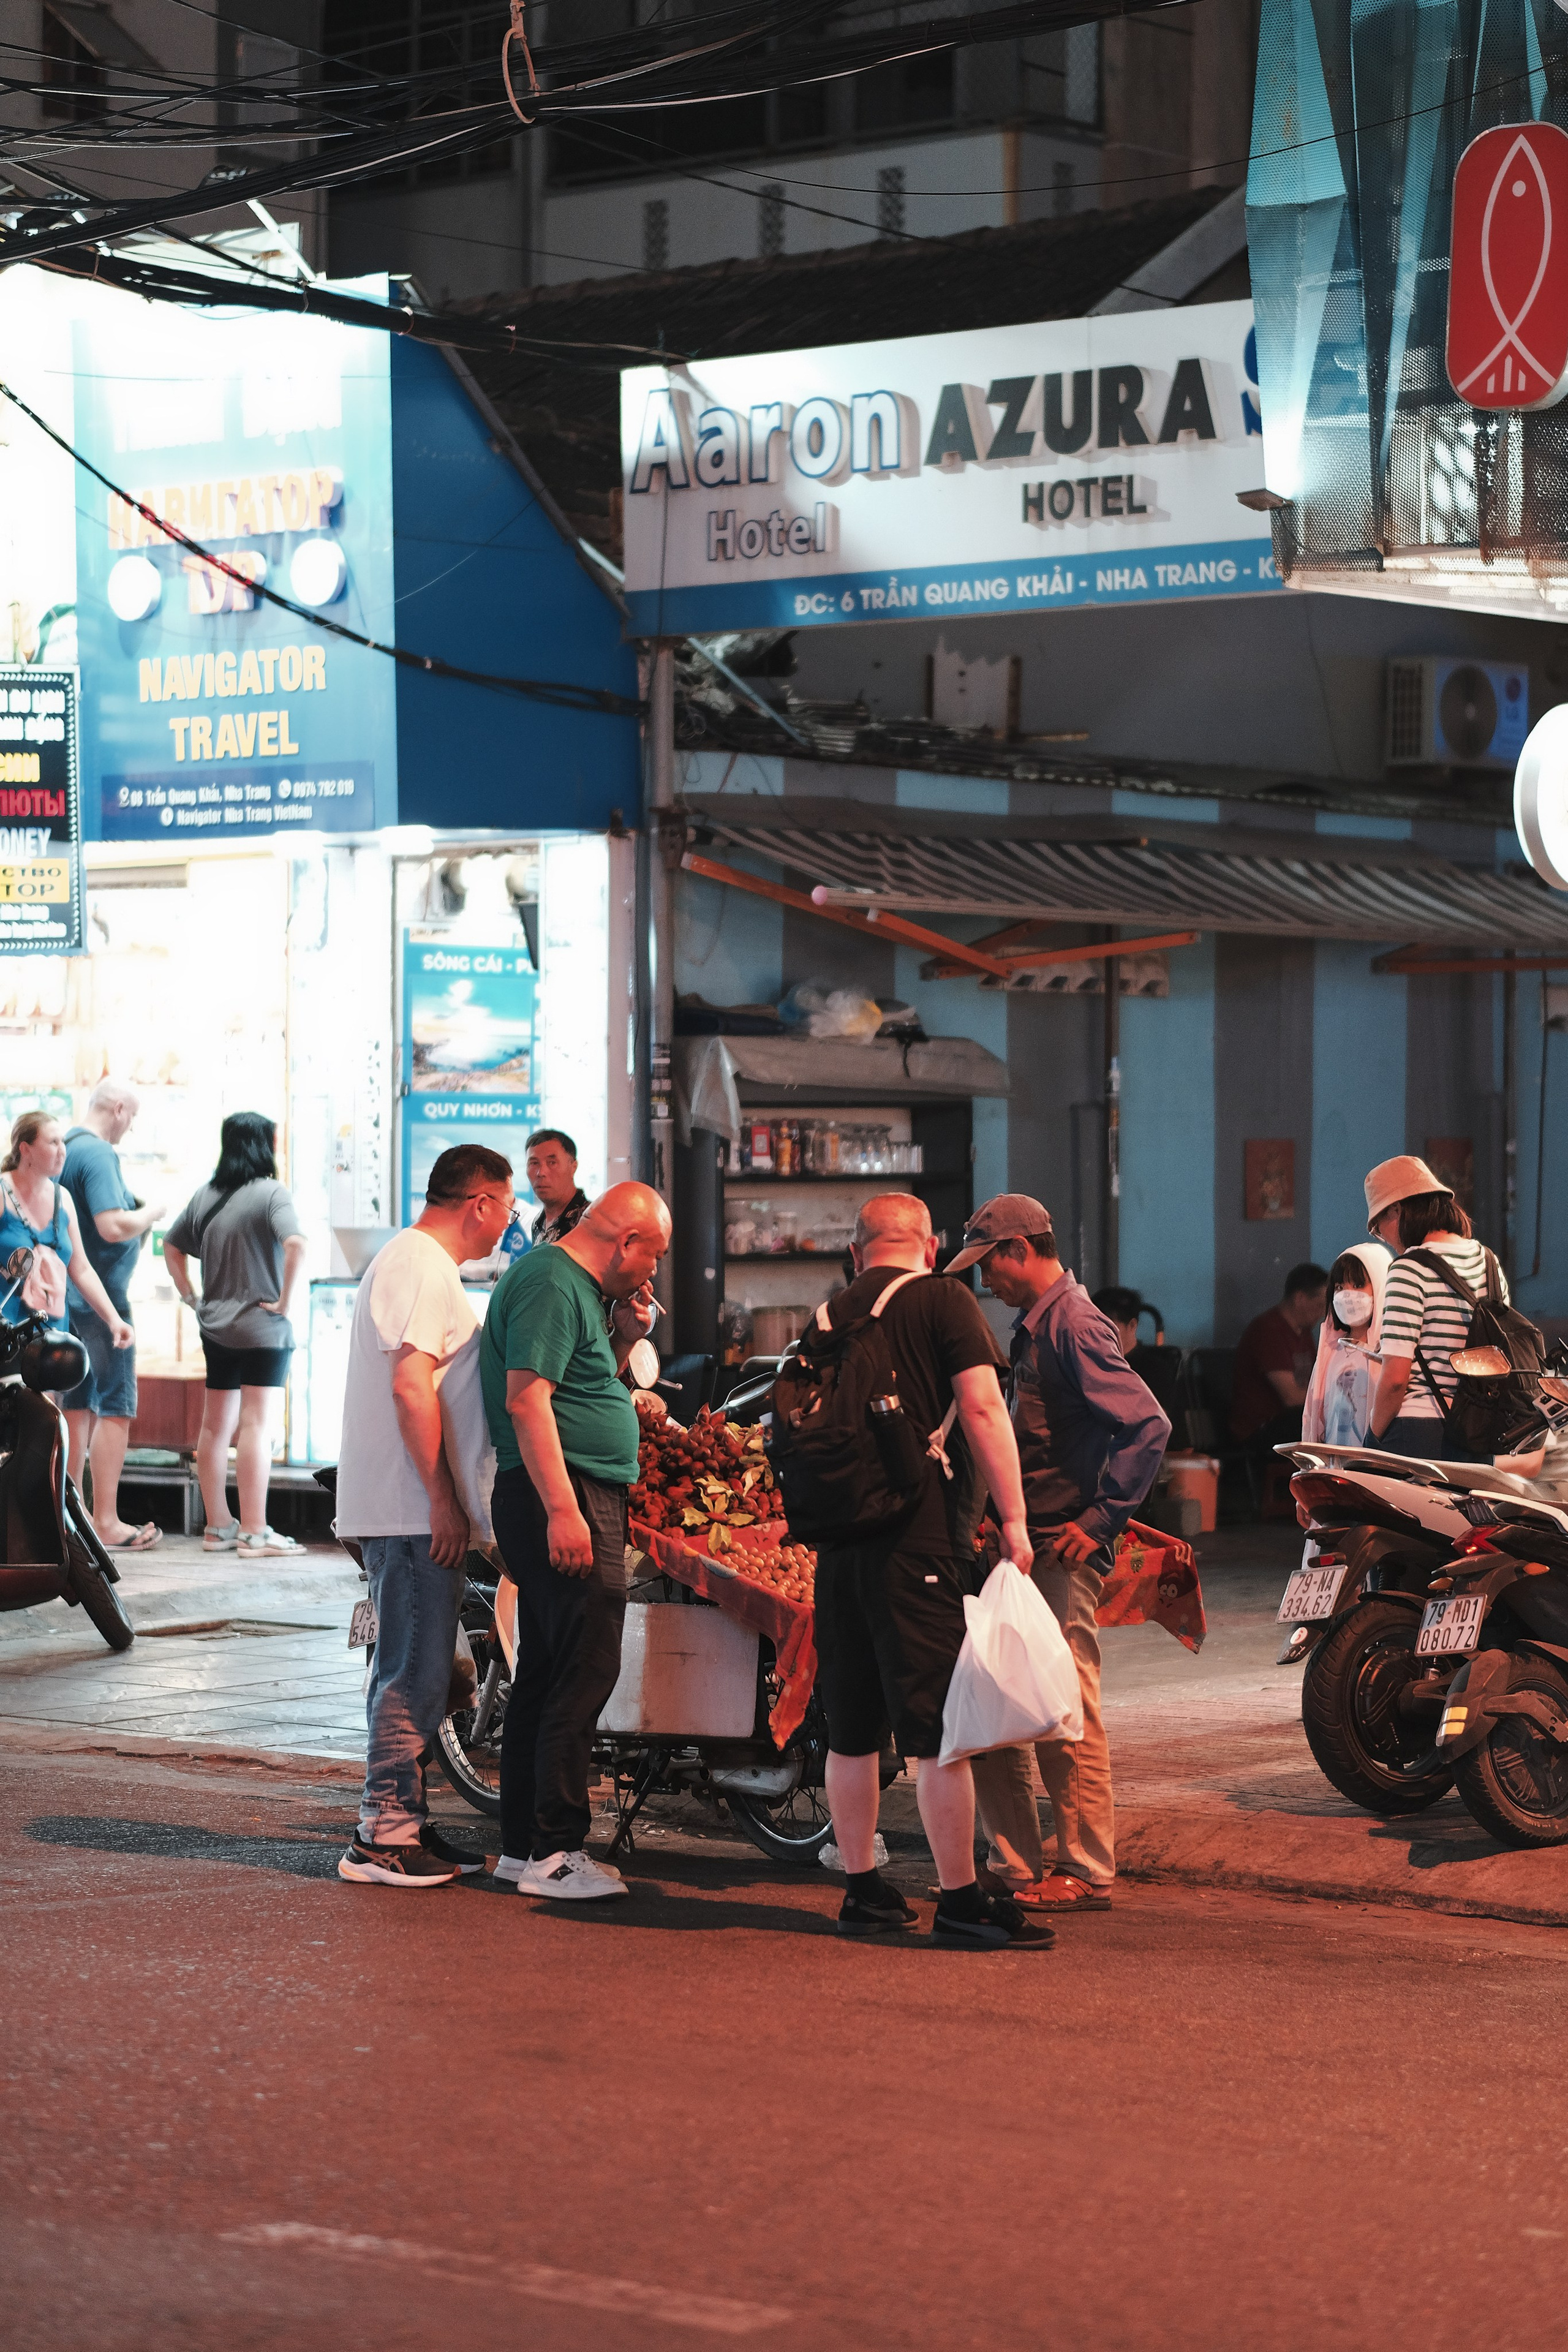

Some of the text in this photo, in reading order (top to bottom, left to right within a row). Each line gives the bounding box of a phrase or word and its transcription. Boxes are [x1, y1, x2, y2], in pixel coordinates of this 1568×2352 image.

[924, 357, 1218, 467] AZURA
[629, 388, 903, 494] Aaron
[1022, 474, 1147, 523] HOTEL
[707, 500, 827, 562] Hotel
[794, 592, 835, 615] ĐC:
[840, 590, 855, 612] 6
[924, 578, 1009, 605] QUANG
[1017, 565, 1072, 598] KHẢI
[1096, 567, 1148, 592] NHA
[1154, 559, 1237, 587] TRANG
[1259, 556, 1281, 579] K
[139, 645, 326, 703] NAVIGATOR
[169, 710, 300, 761] TRAVEL
[168, 788, 197, 806] Quang
[224, 785, 243, 802] Nha
[245, 783, 271, 802] Trang
[177, 808, 222, 827] Navigator
[224, 807, 244, 824] Nha
[246, 806, 272, 824] Trang
[423, 951, 470, 971] SÔNG
[473, 952, 502, 973] CÁI
[424, 1102, 459, 1119] QUY
[1294, 1570, 1336, 1595] 79-NA
[359, 1602, 373, 1623] 79
[1283, 1594, 1332, 1618] 334.62
[1420, 1624, 1474, 1652] 080.72
